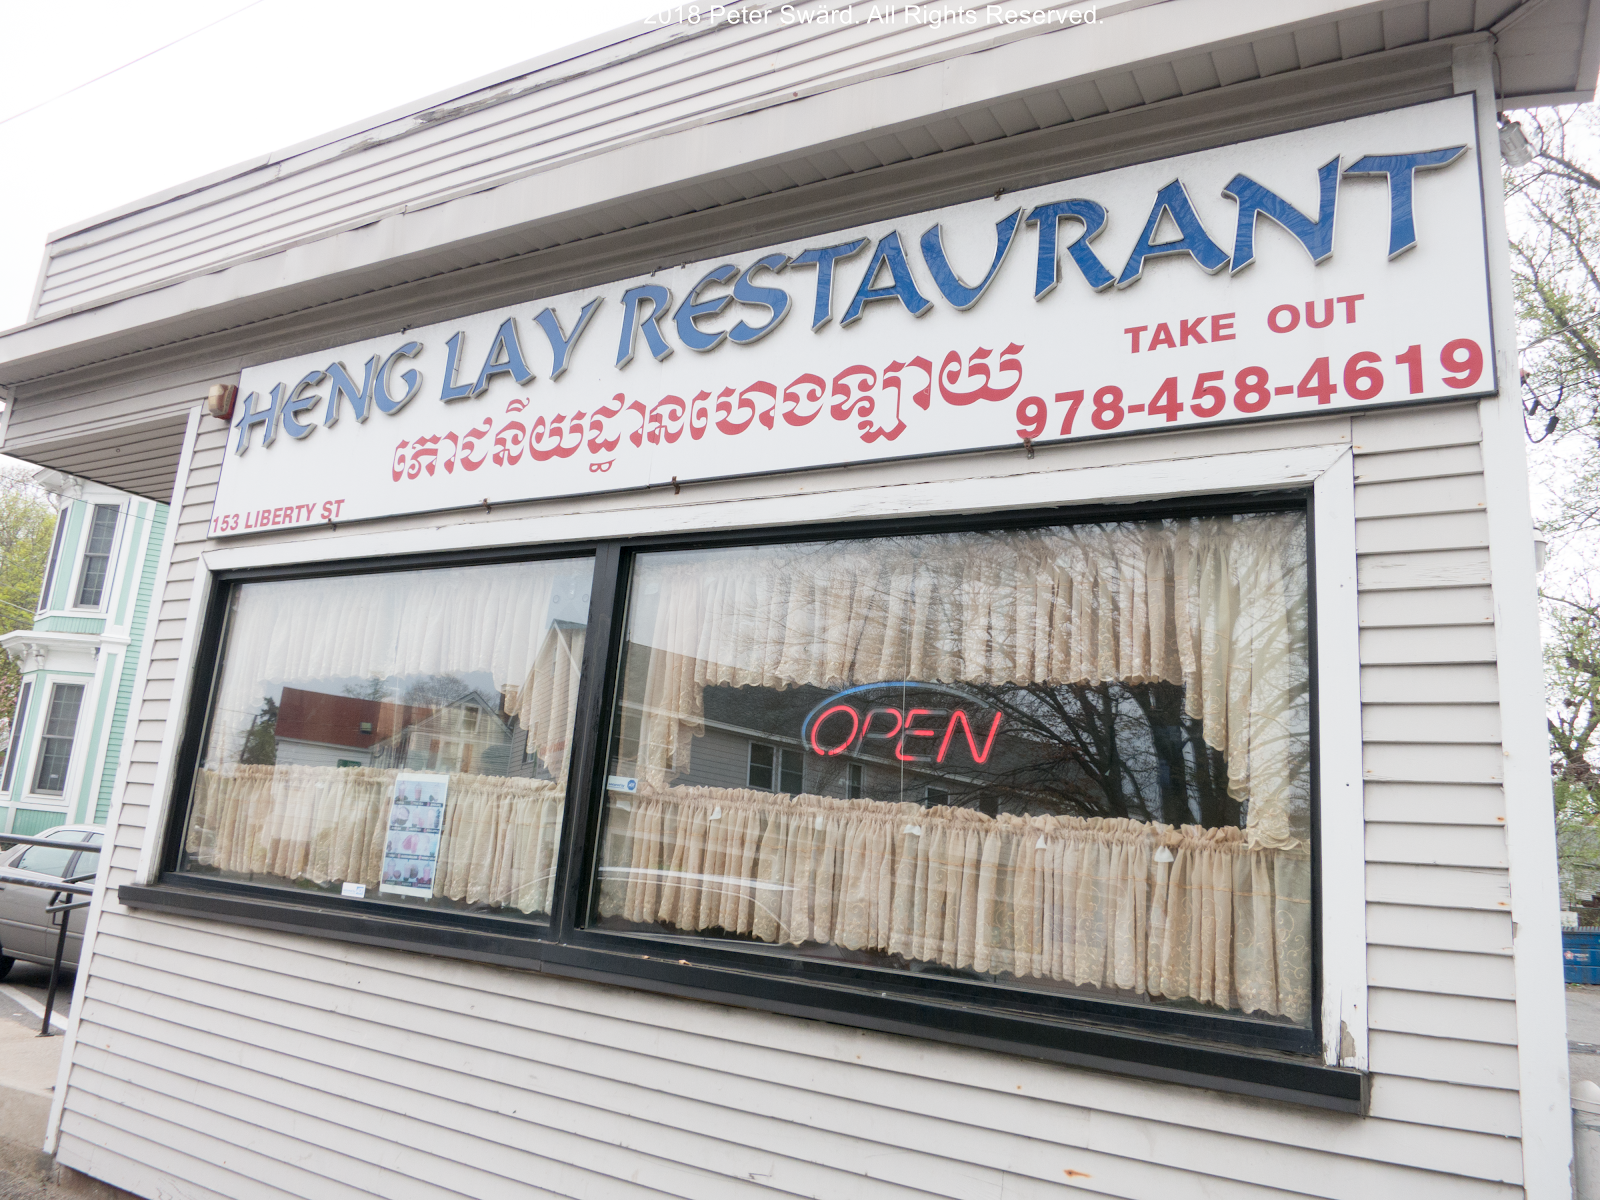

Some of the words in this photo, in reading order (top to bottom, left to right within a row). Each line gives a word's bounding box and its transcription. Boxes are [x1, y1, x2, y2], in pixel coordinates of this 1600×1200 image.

[234, 341, 424, 457] HENG
[439, 297, 604, 404] LAY
[614, 144, 1468, 370] RESTAURANT
[1124, 312, 1236, 354] TAKE
[1267, 293, 1365, 334] OUT
[1015, 338, 1485, 440] 978-458-4619
[213, 513, 240, 533] 153
[244, 502, 317, 529] LIBERTY
[320, 498, 345, 520] ST
[811, 705, 1002, 764] OPEN
